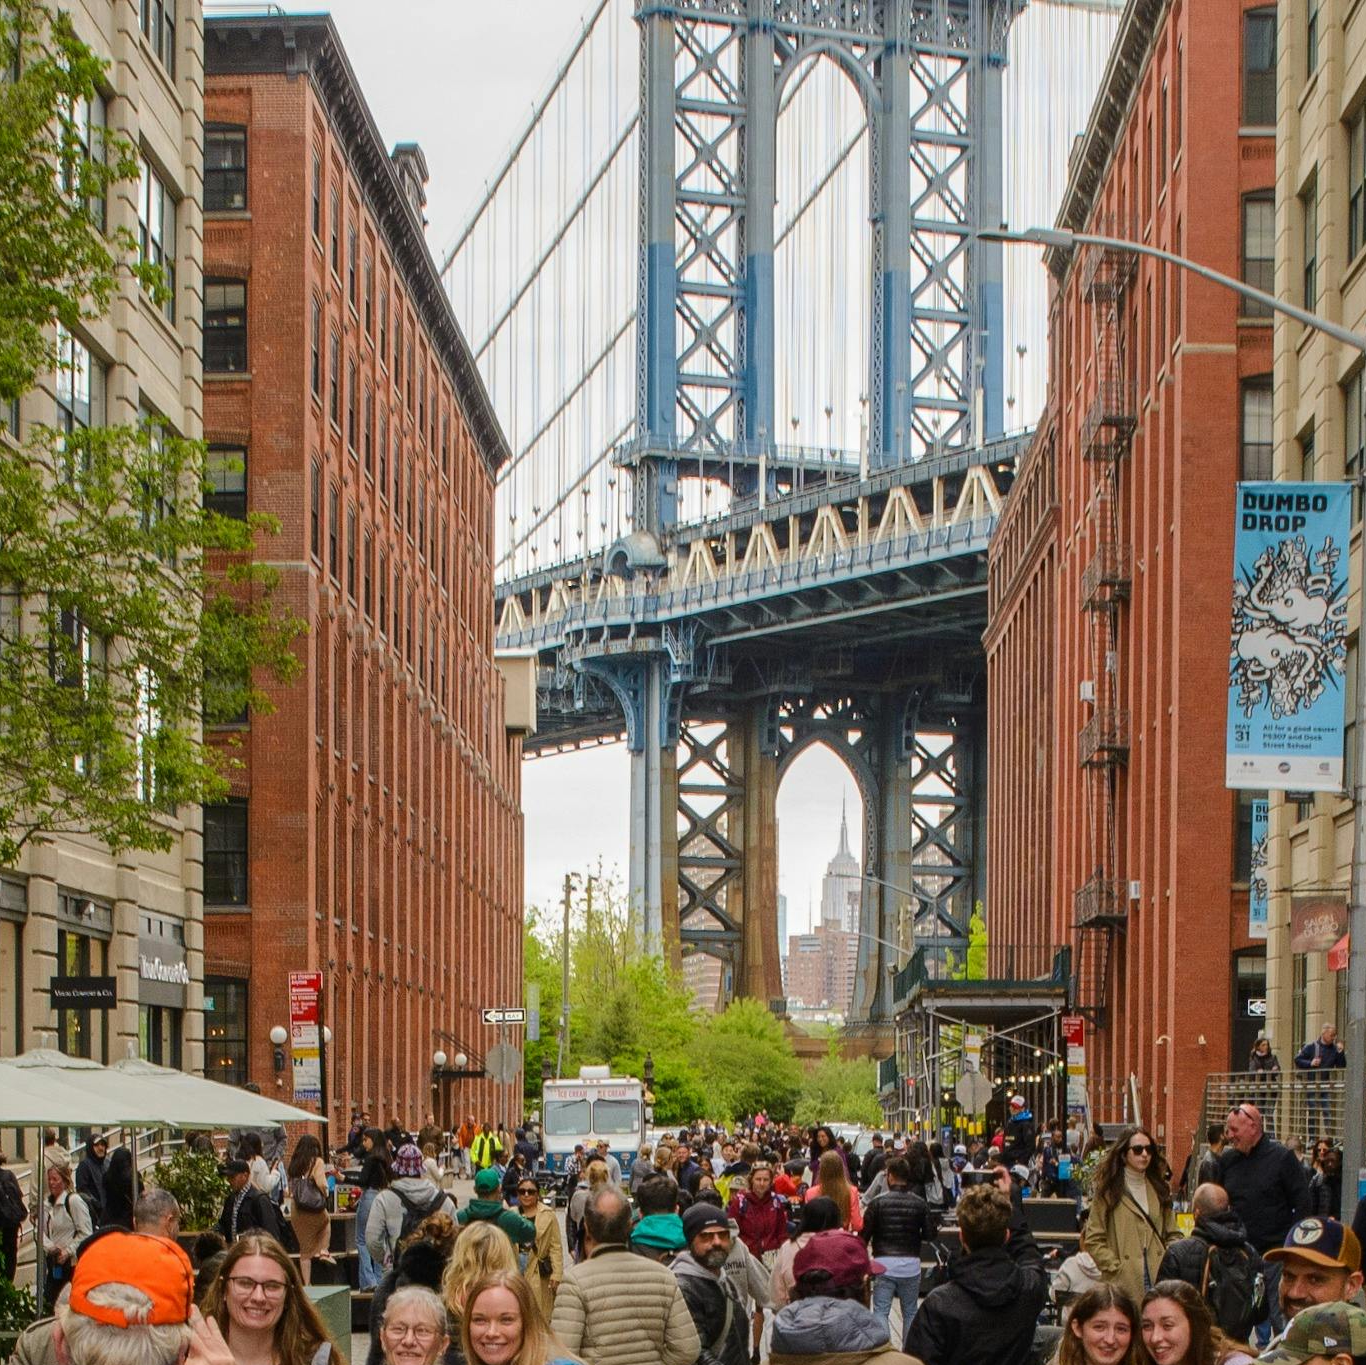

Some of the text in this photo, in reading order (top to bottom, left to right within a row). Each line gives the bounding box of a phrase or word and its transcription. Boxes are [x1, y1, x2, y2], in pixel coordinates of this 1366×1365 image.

[1243, 493, 1327, 512] DUMBO
[1242, 513, 1306, 532] DROP
[1235, 731, 1250, 742] 31
